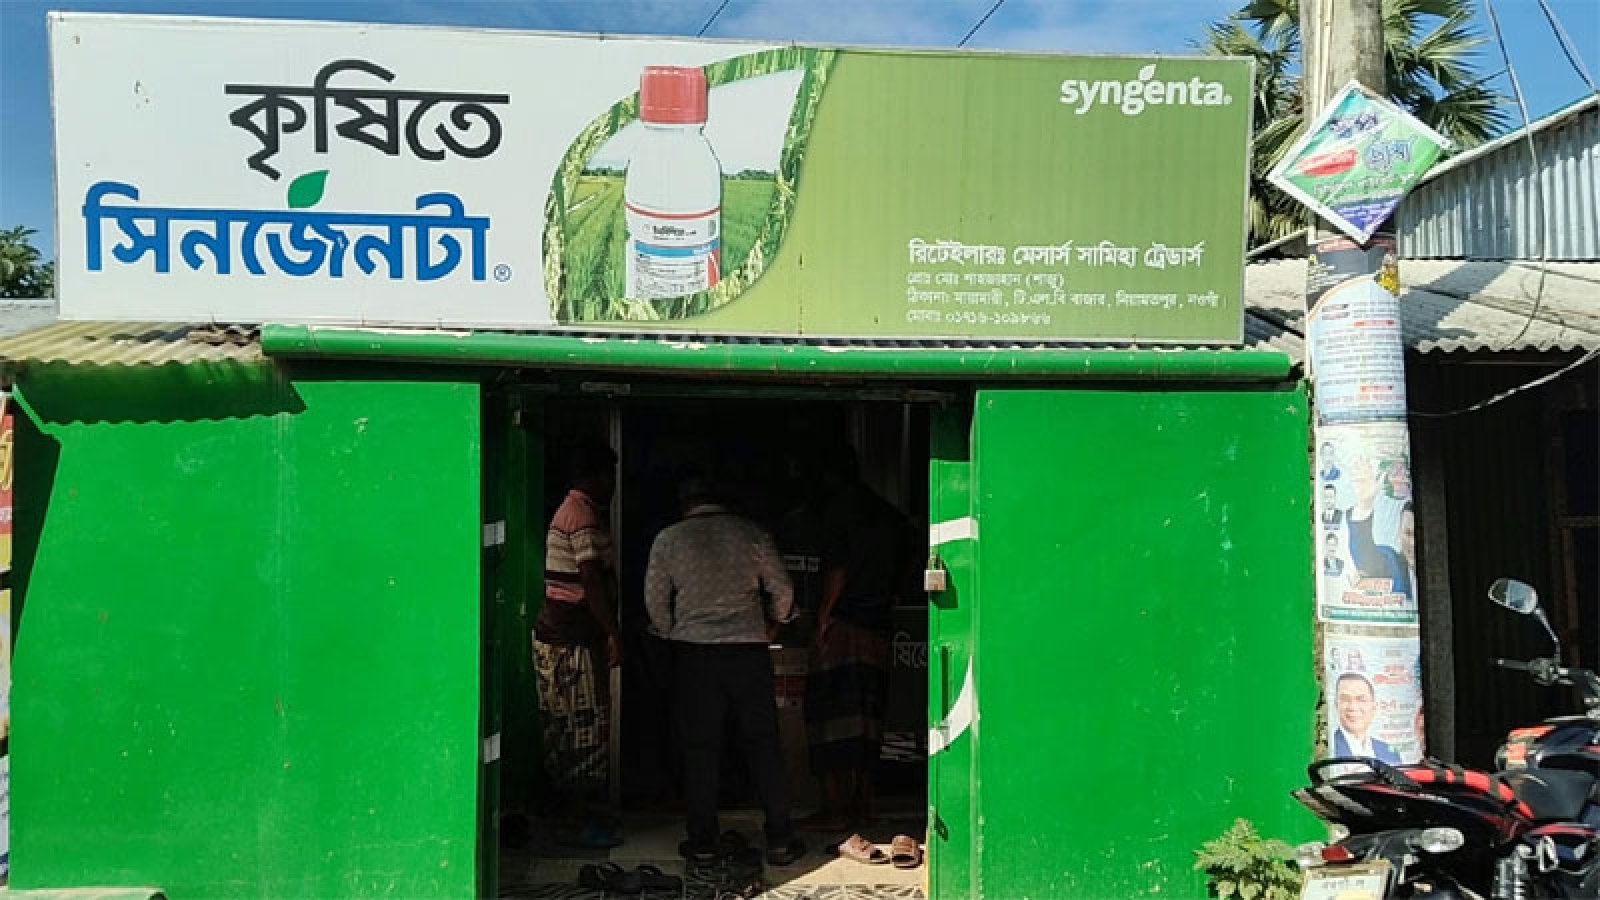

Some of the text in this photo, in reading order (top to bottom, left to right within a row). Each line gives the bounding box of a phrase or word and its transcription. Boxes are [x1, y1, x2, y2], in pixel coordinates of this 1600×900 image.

[224, 59, 509, 181] কৃষিতে
[1060, 75, 1224, 115] syngenta
[82, 181, 491, 281] সিনজেনটা
[1013, 240, 1073, 266] মেসার্স
[1144, 240, 1206, 269] ট্রেডার্স
